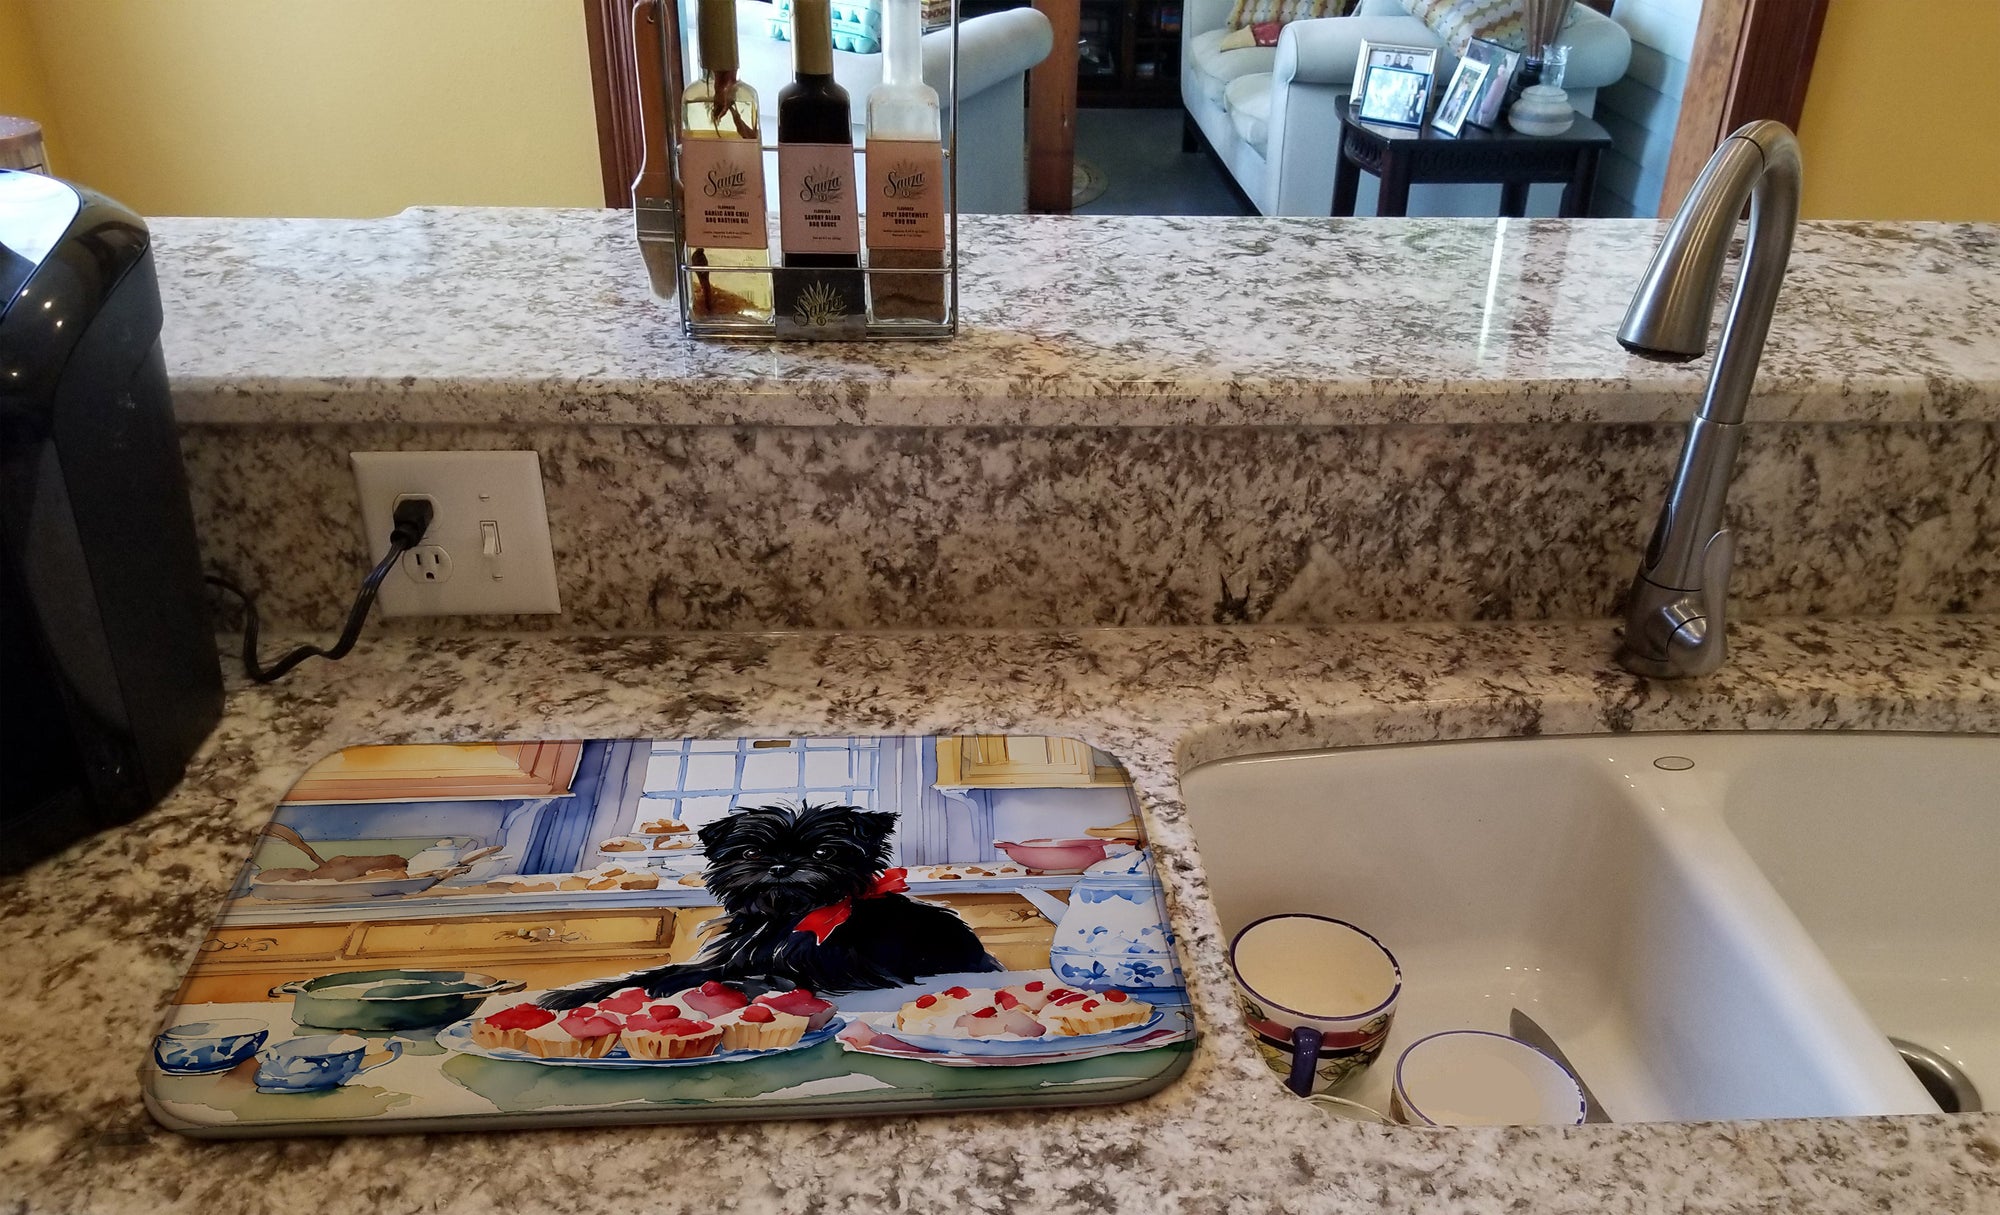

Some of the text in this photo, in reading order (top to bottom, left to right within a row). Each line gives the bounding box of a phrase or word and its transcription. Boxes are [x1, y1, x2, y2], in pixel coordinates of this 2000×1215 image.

[703, 170, 745, 197] Sauza
[799, 175, 841, 202] Sauza
[883, 171, 924, 198] Sauza
